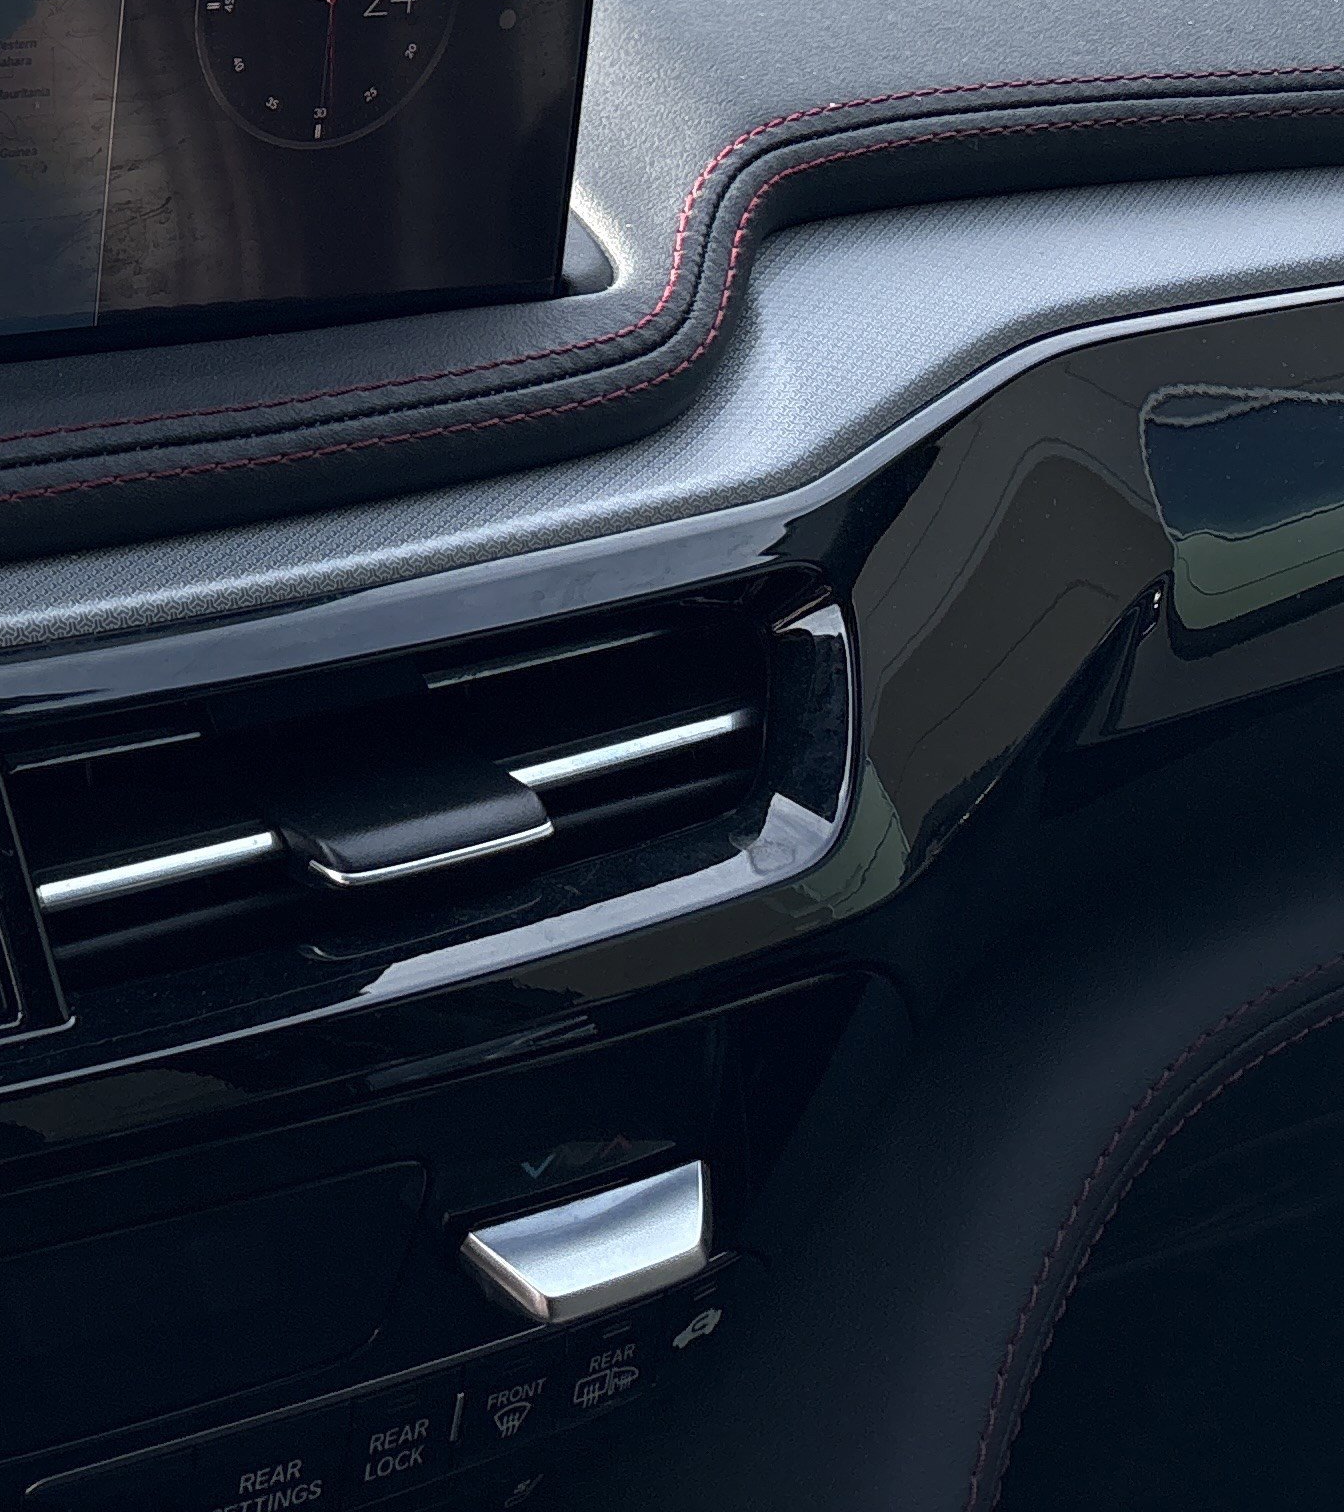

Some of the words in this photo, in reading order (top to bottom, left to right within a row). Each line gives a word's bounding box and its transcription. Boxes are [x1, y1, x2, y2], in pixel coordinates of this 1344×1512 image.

[589, 1344, 636, 1372] REAR
[486, 1378, 548, 1409] FRONT
[369, 1419, 429, 1454] REAR
[239, 1459, 303, 1494] REAR
[364, 1445, 424, 1481] LOCK
[213, 1479, 323, 1512] ETTINGS
